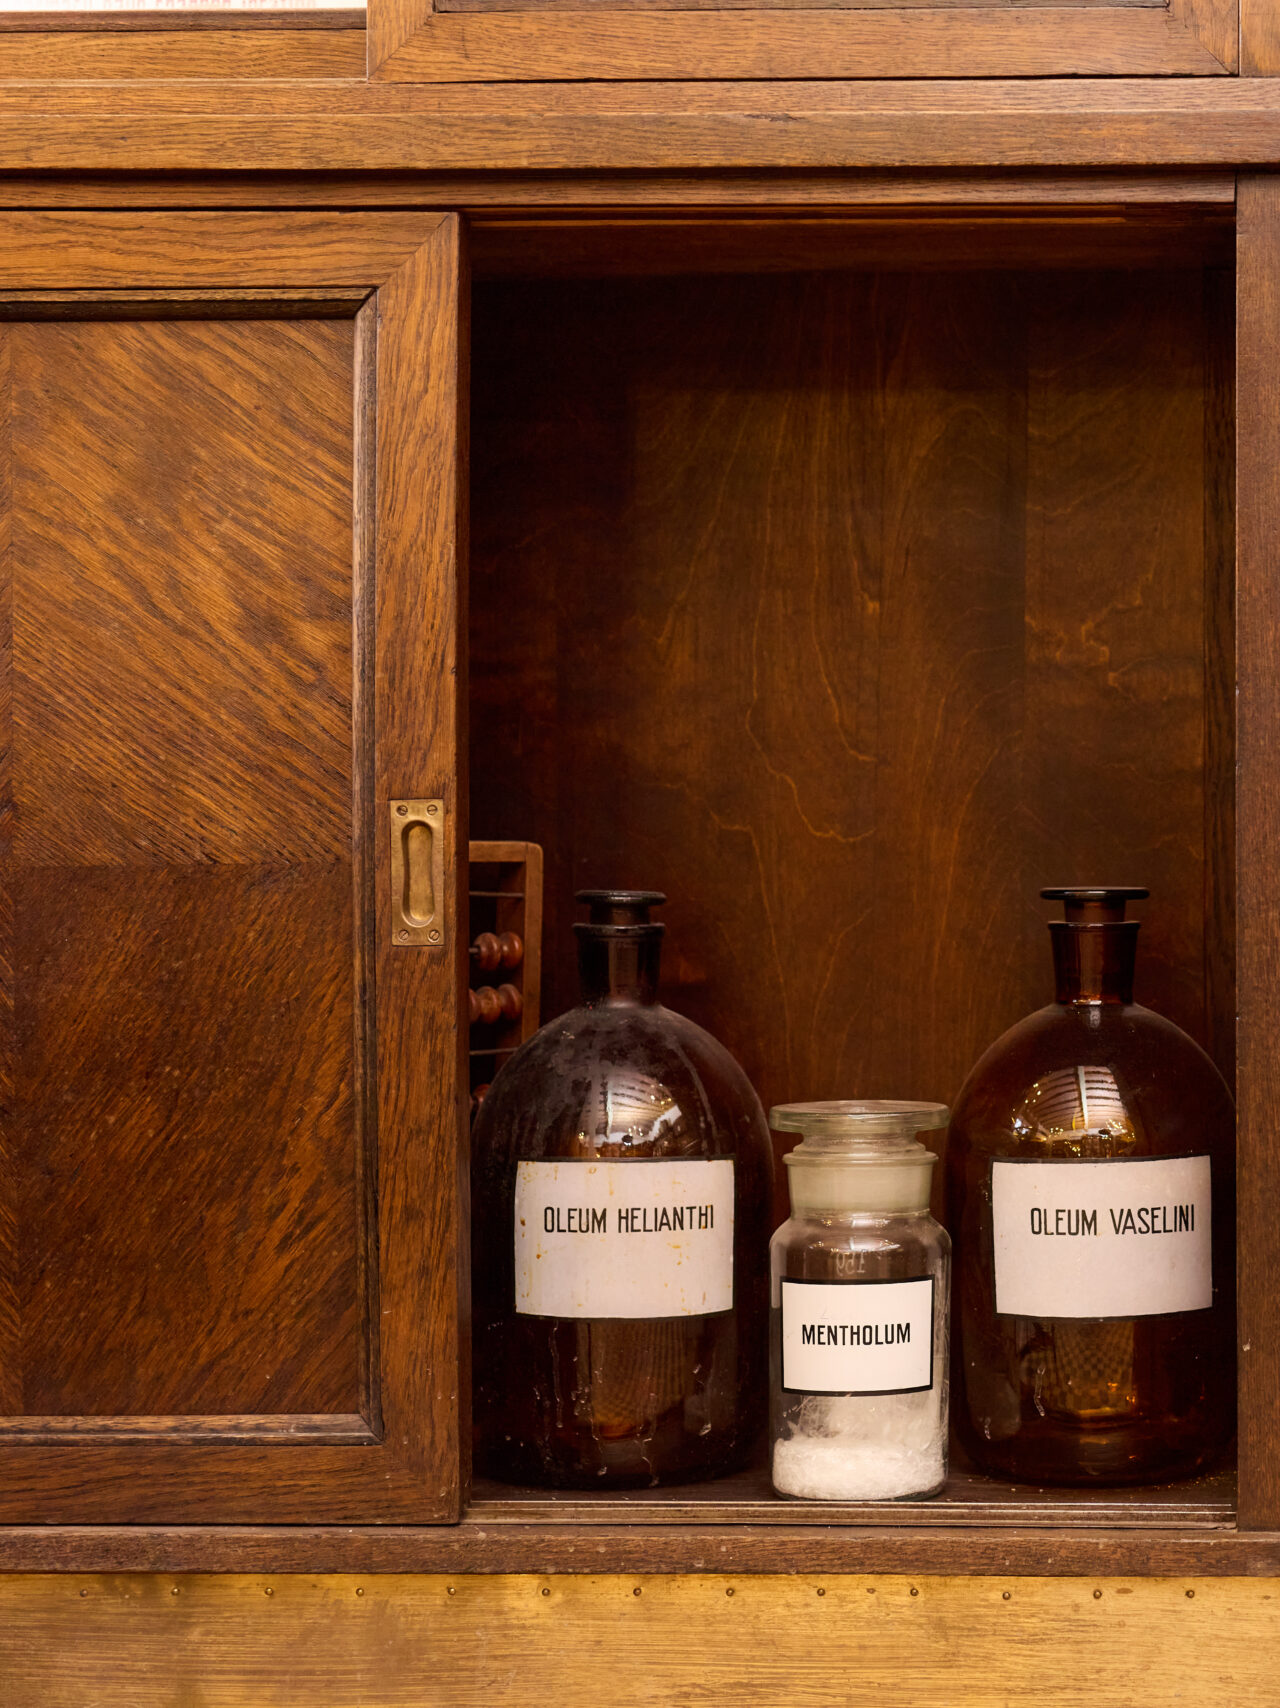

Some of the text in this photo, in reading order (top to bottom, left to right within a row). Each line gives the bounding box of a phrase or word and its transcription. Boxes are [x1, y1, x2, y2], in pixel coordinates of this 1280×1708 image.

[543, 1204, 715, 1234] OLEUM HELIANTHI
[1030, 1203, 1196, 1236] OLEUM VASELINI
[801, 1322, 912, 1346] MENTHOLUM
